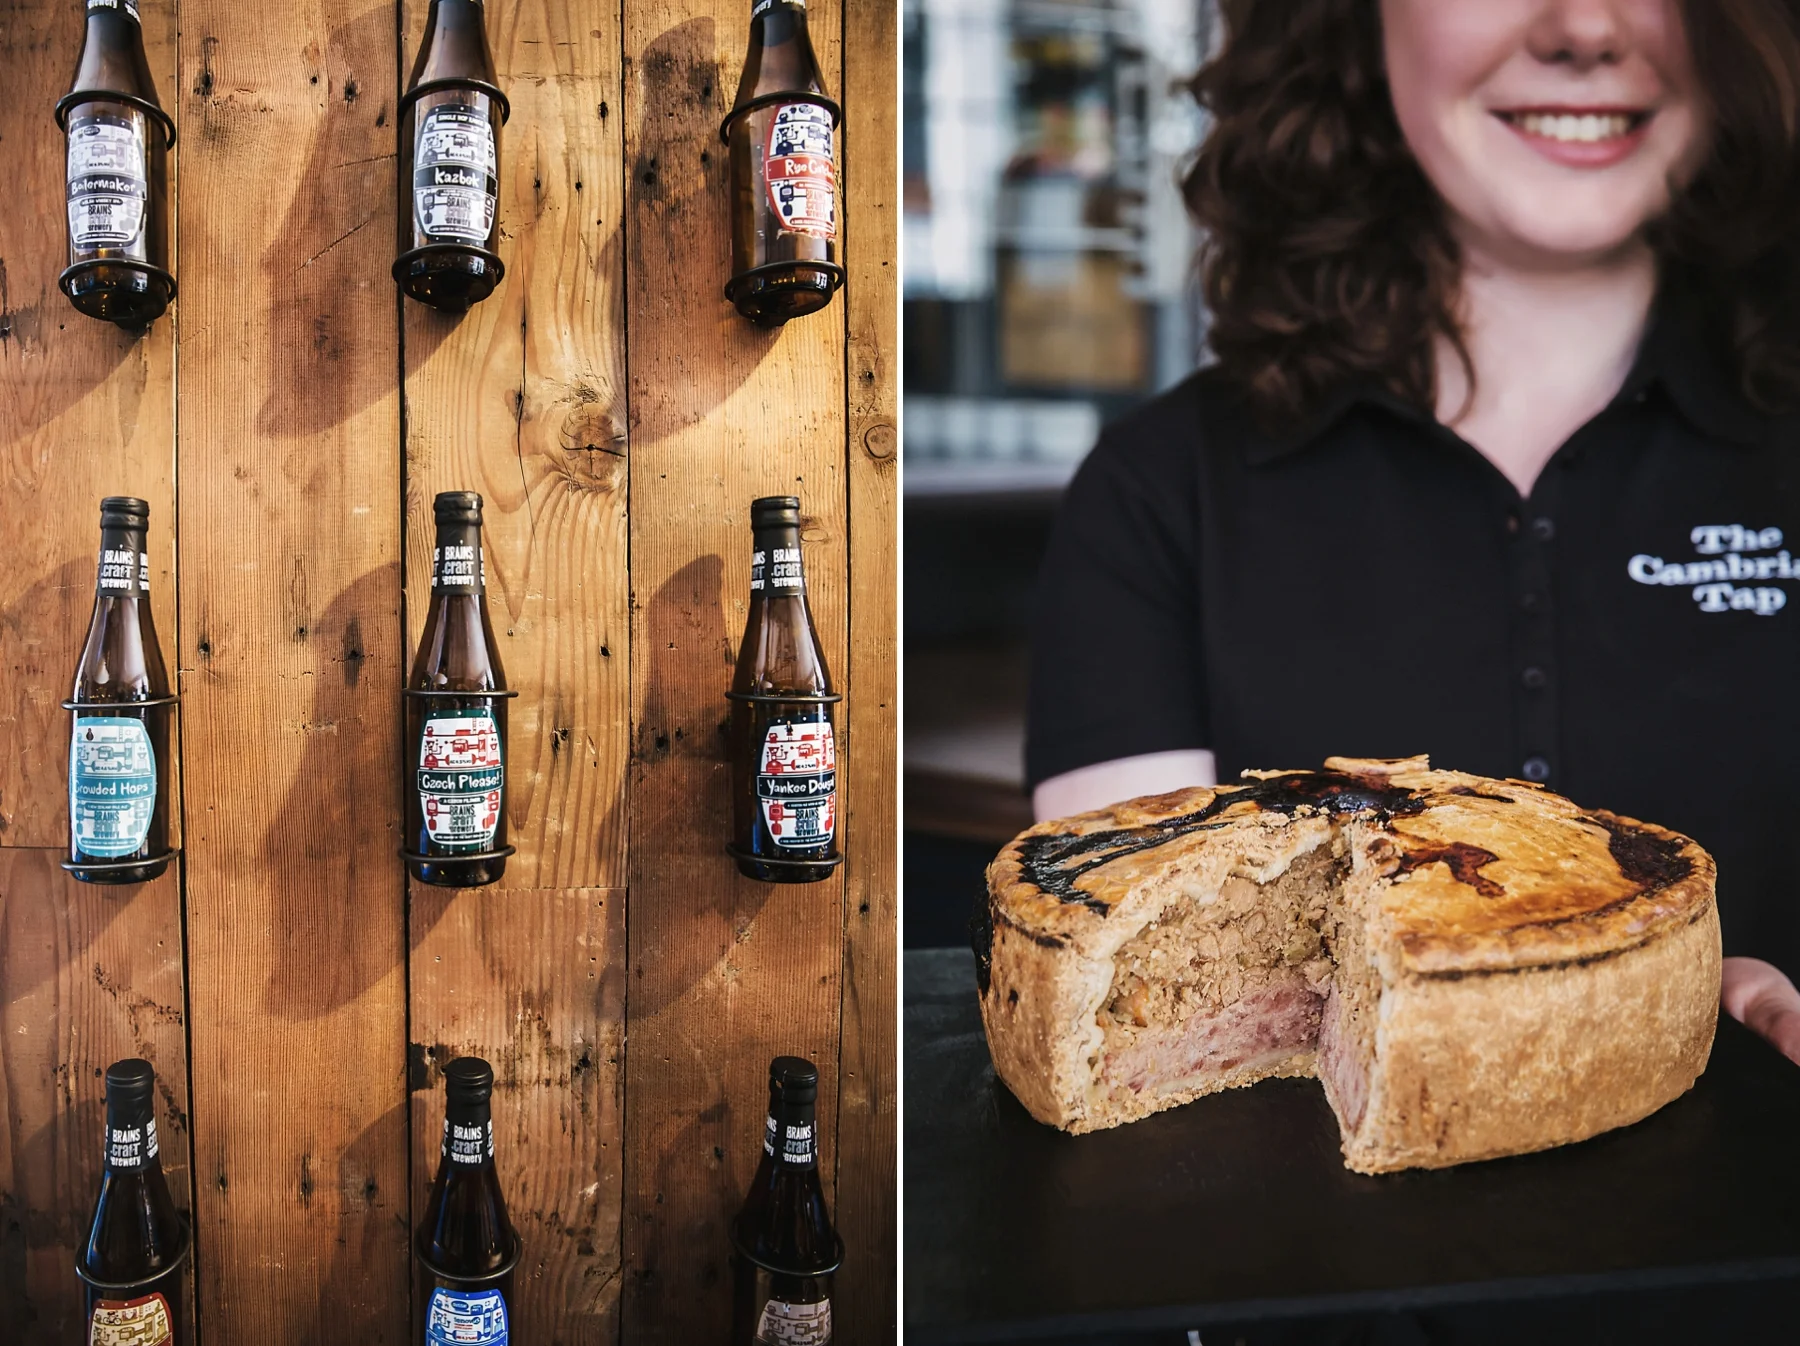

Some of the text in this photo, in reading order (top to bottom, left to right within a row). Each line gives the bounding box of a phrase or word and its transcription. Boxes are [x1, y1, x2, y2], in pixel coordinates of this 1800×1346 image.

[435, 167, 480, 188] Kazbek
[88, 204, 113, 215] BRAINS
[1690, 523, 1784, 555] The
[104, 550, 134, 565] BRAINS
[445, 546, 474, 560] BRAINS
[773, 548, 800, 562] BRAINS
[1692, 582, 1787, 616] Tap
[120, 781, 149, 795] Hops
[422, 771, 500, 790] Czech Please!
[766, 779, 807, 796] Yankee
[449, 805, 475, 816] BRAINS
[795, 807, 820, 820] BRAINS
[112, 1128, 141, 1143] BRAINS
[454, 1125, 482, 1140] BRAINS
[786, 1125, 812, 1140] BRAINS
